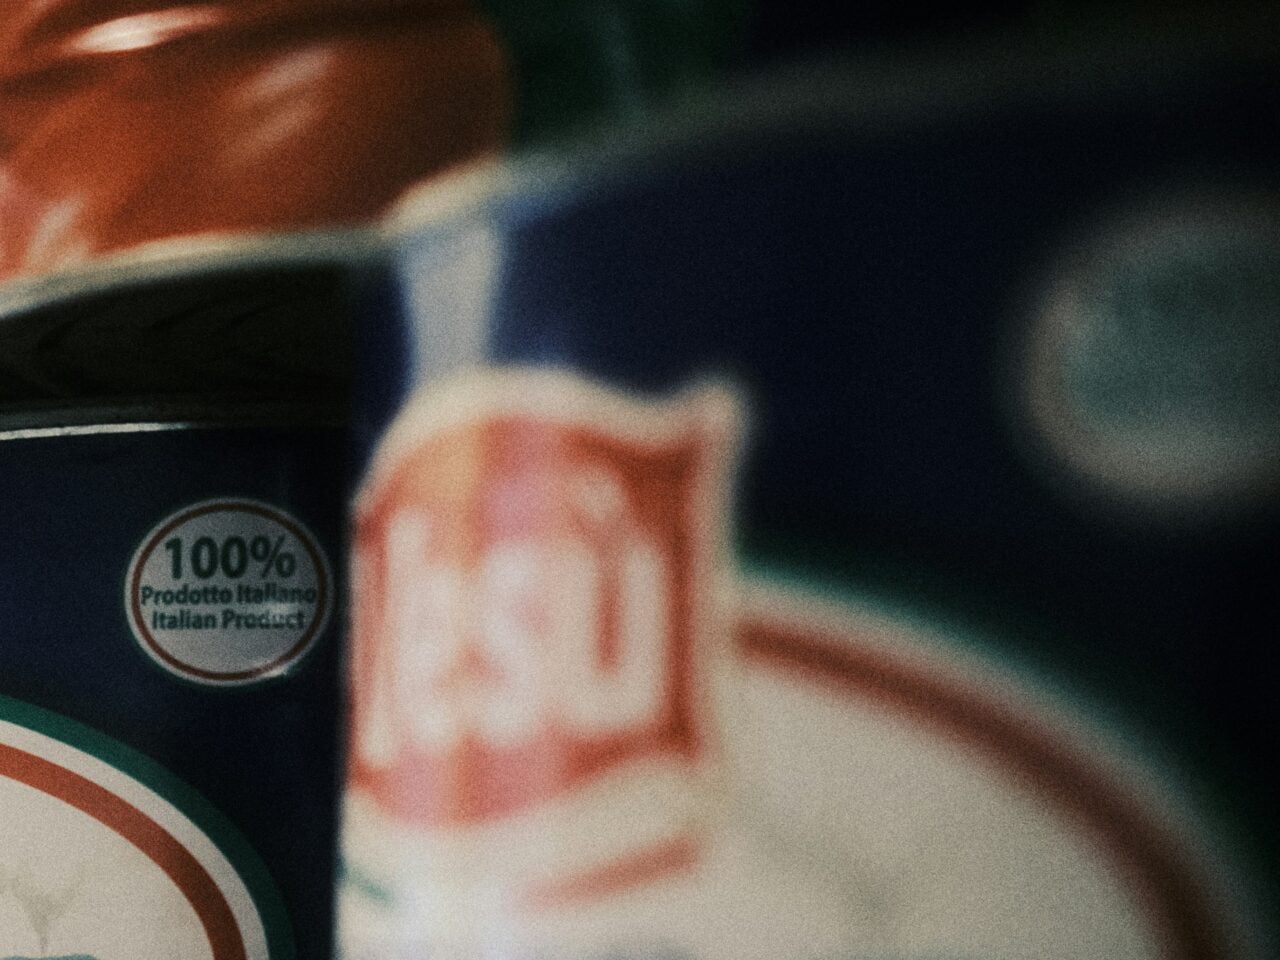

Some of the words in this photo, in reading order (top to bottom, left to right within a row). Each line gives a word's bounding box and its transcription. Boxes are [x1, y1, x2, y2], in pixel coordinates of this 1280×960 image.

[165, 535, 296, 580] 100%
[141, 584, 233, 606] Prodotto
[237, 582, 317, 604] Italiano
[152, 609, 217, 630] Italian
[221, 608, 304, 630] Product
